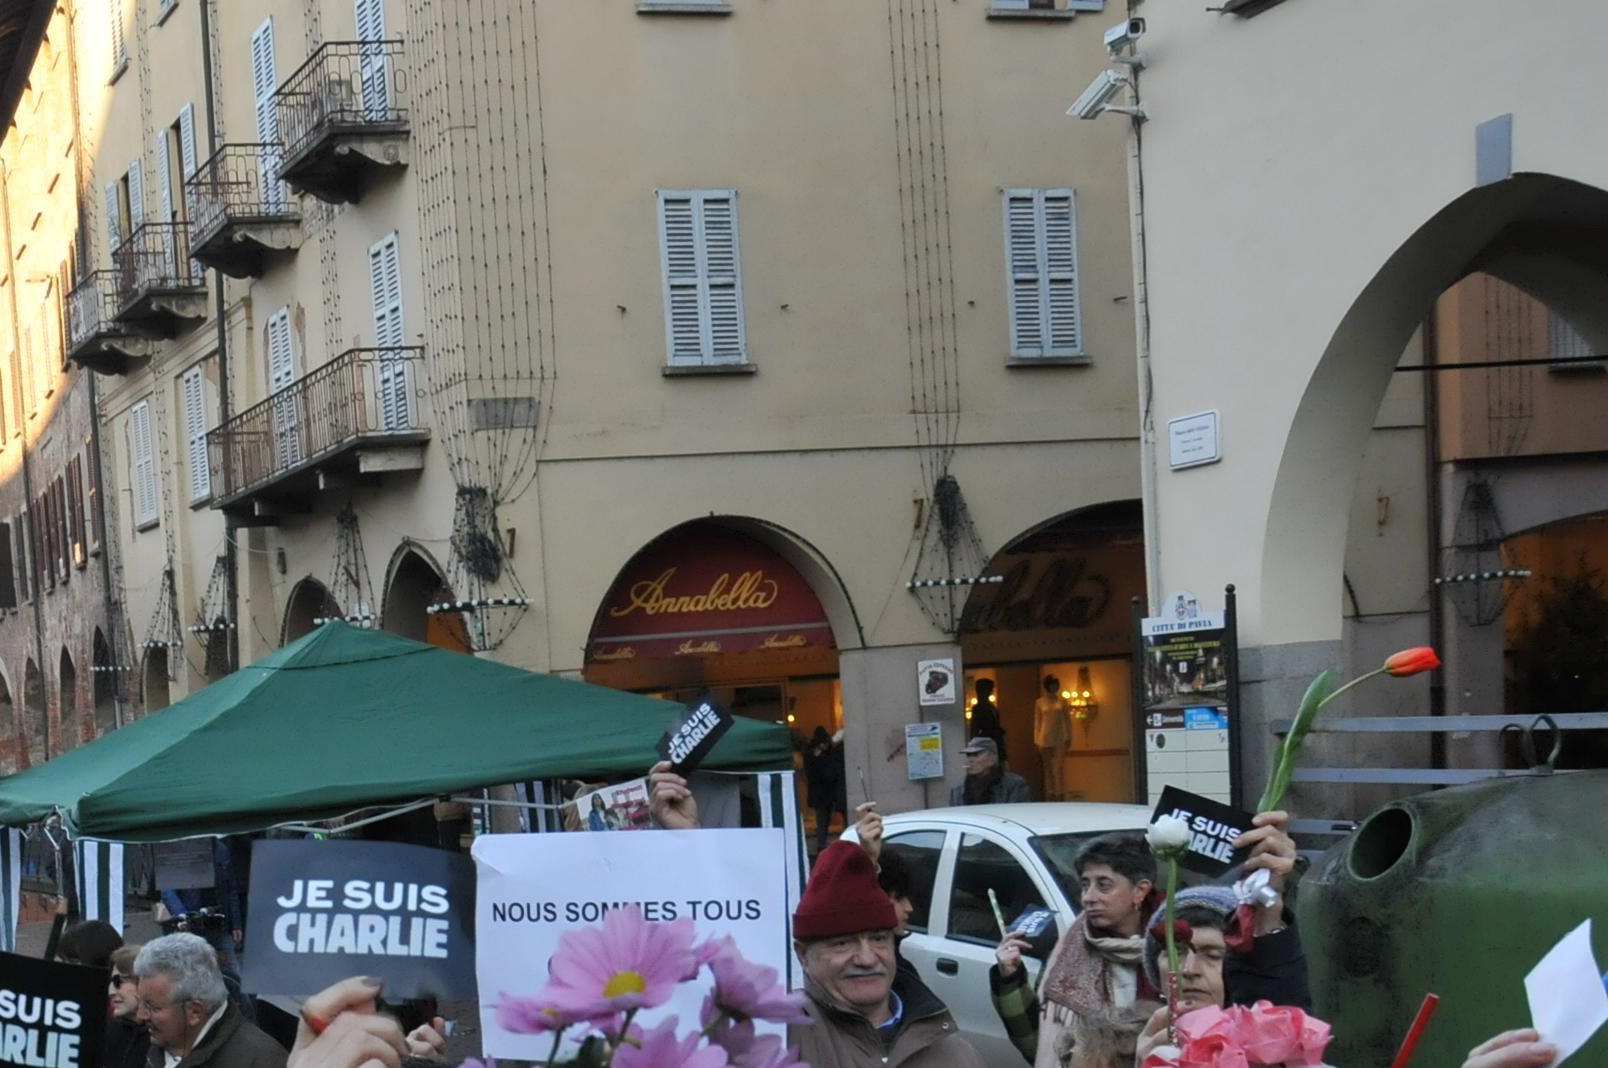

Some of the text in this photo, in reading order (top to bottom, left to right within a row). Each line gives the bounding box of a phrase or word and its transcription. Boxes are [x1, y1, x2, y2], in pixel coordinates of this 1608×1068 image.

[611, 567, 778, 616] Annabella
[1188, 620, 1212, 629] PAVIA
[668, 703, 711, 754] JE SUIS
[671, 710, 721, 764] CHARLIE
[1192, 816, 1241, 842] SUIS
[277, 880, 449, 914] JE SUIS
[493, 902, 557, 922] NOUS
[686, 900, 761, 921] TOUS
[273, 912, 449, 958] CHARLIE
